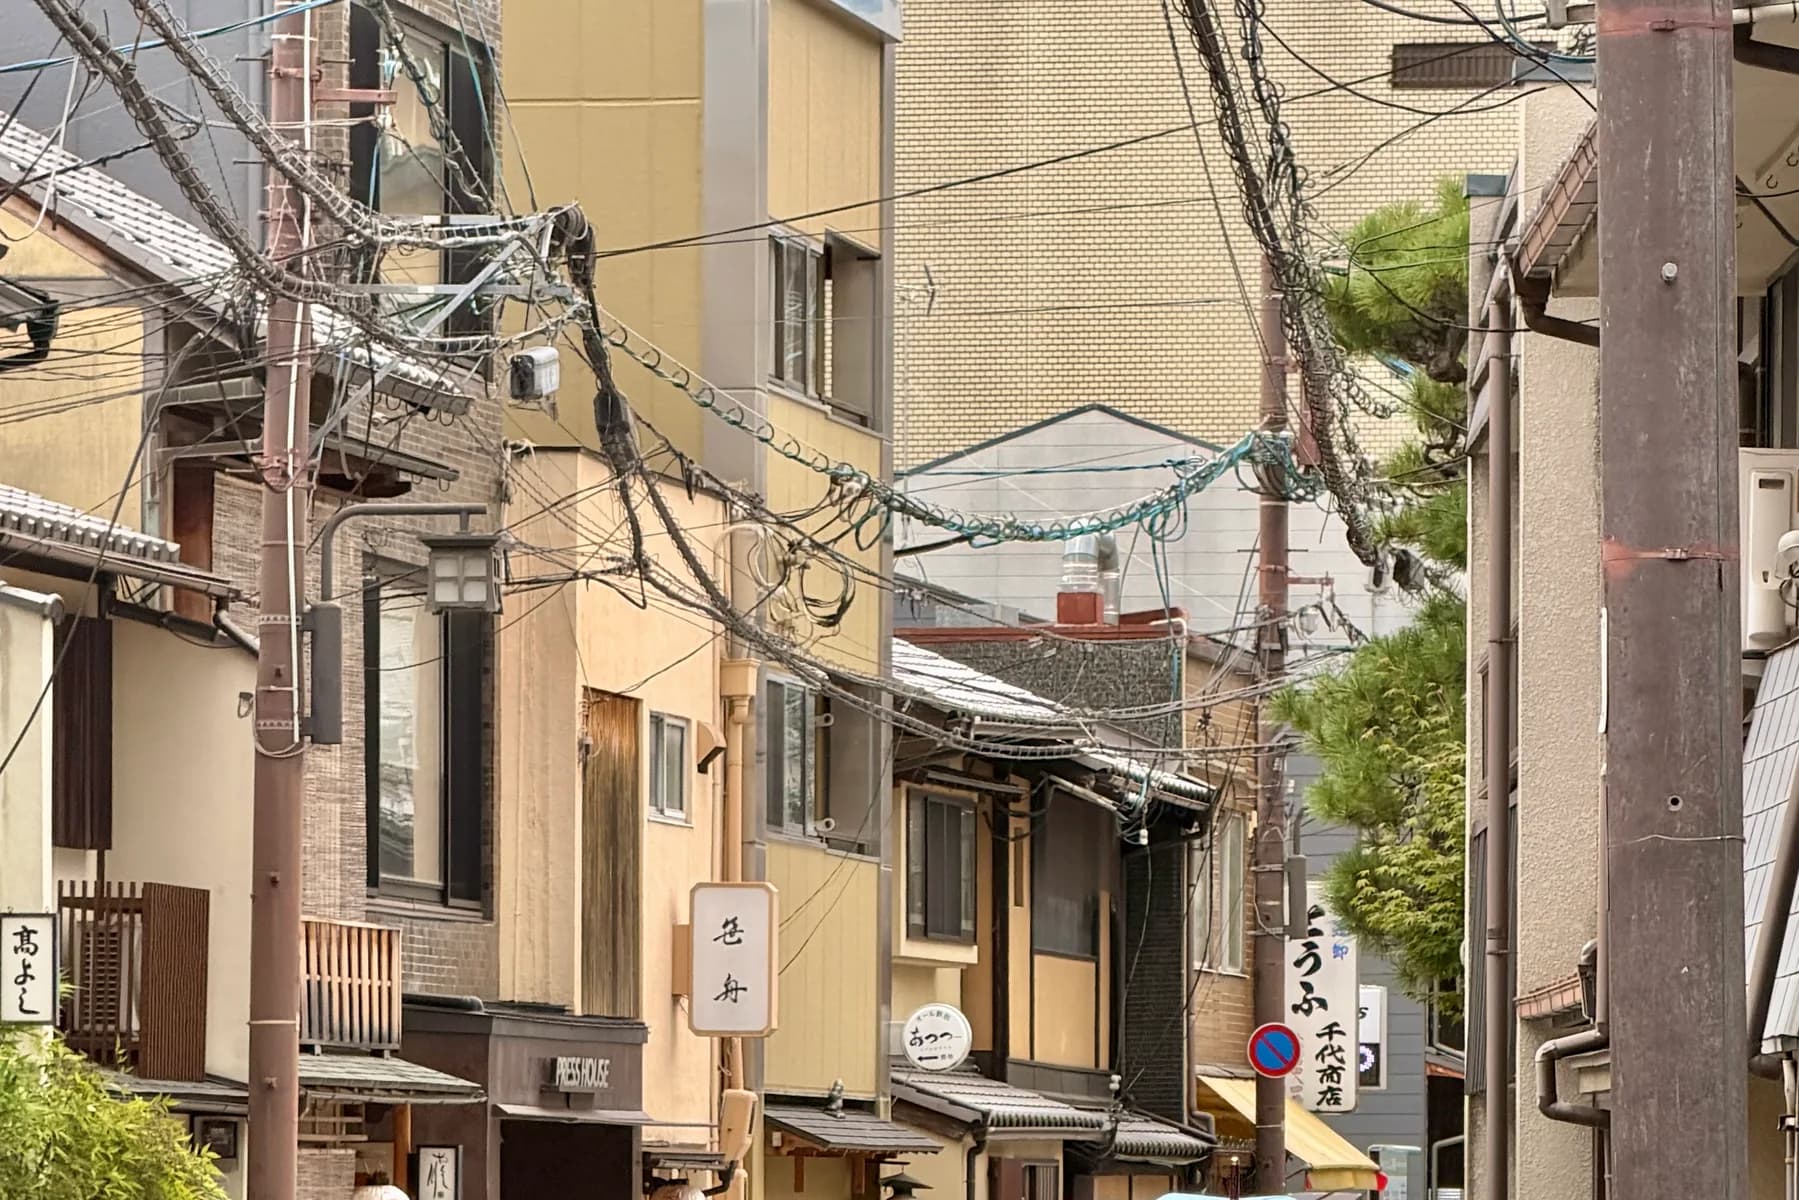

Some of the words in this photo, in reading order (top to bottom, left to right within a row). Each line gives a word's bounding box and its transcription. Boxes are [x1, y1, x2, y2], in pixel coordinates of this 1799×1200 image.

[712, 916, 748, 1003] 笹舟
[556, 1056, 581, 1087] PRESS
[581, 1057, 611, 1088] HOUSE
[1314, 1021, 1347, 1106] 千代商店
